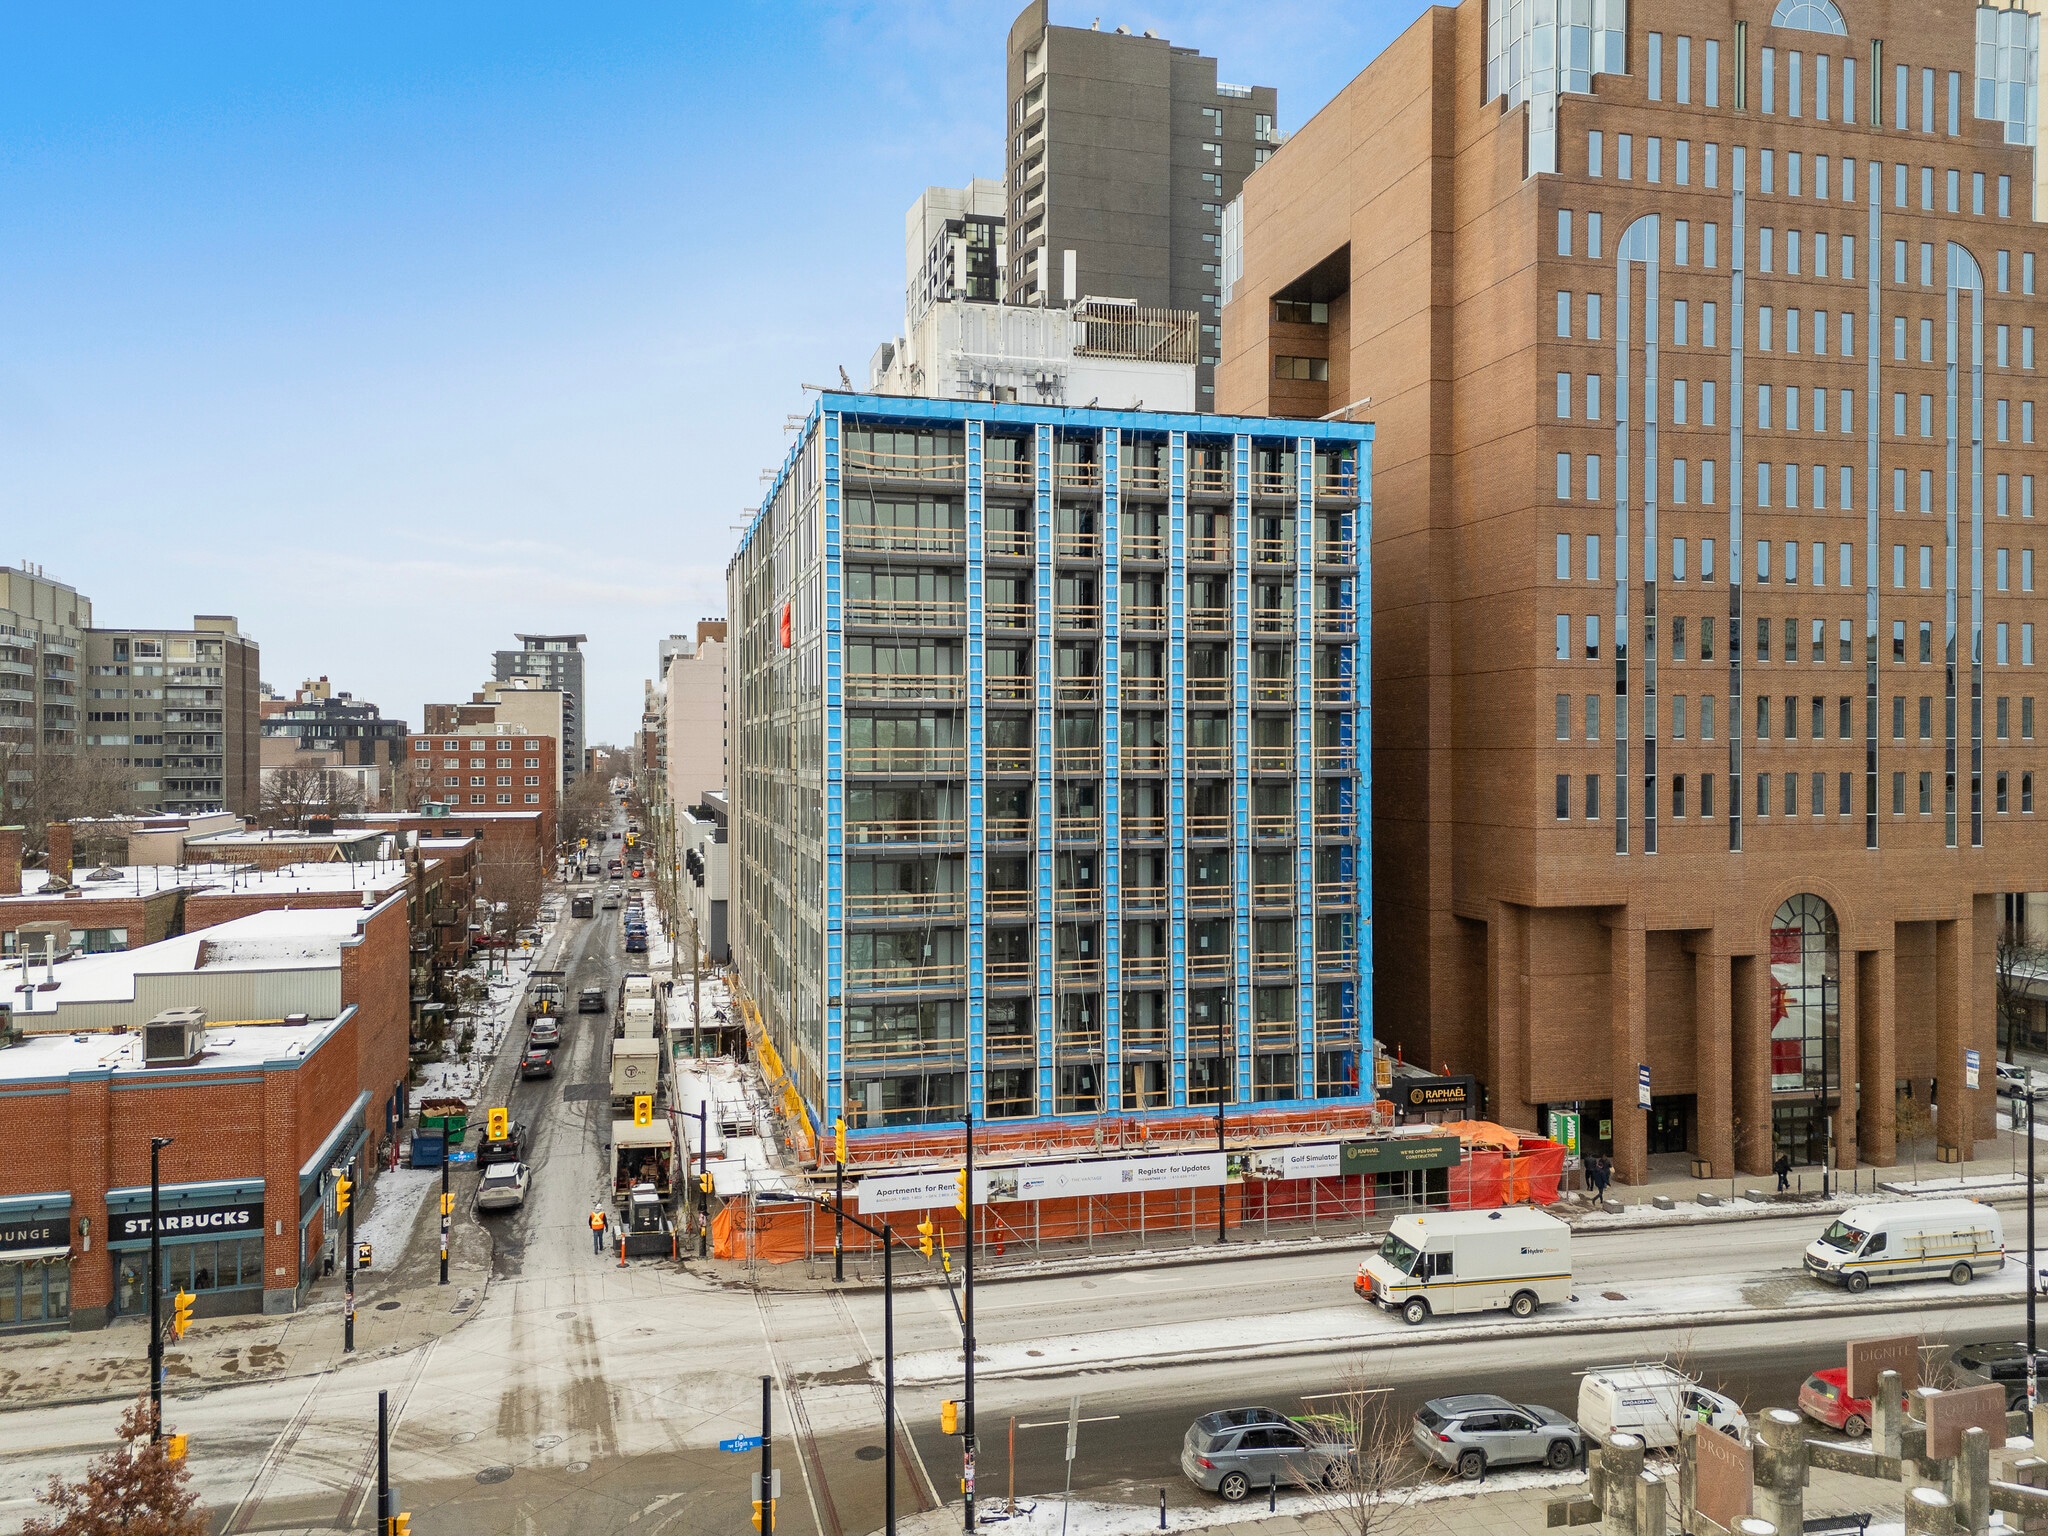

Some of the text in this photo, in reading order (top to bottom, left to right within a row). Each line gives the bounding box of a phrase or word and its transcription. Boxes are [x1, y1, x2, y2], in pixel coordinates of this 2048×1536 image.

[1290, 1153, 1338, 1163] Golf Simulator
[1138, 1167, 1167, 1176] Register
[1181, 1164, 1211, 1173] Updates
[876, 1183, 956, 1197] Apartments for Rent
[124, 1210, 250, 1233] STARBUCKS
[0, 1228, 50, 1242] UNGE
[1622, 1398, 1657, 1406] BROADBAND
[735, 1440, 748, 1449] Elgin
[1697, 1434, 1745, 1472] DROITS
